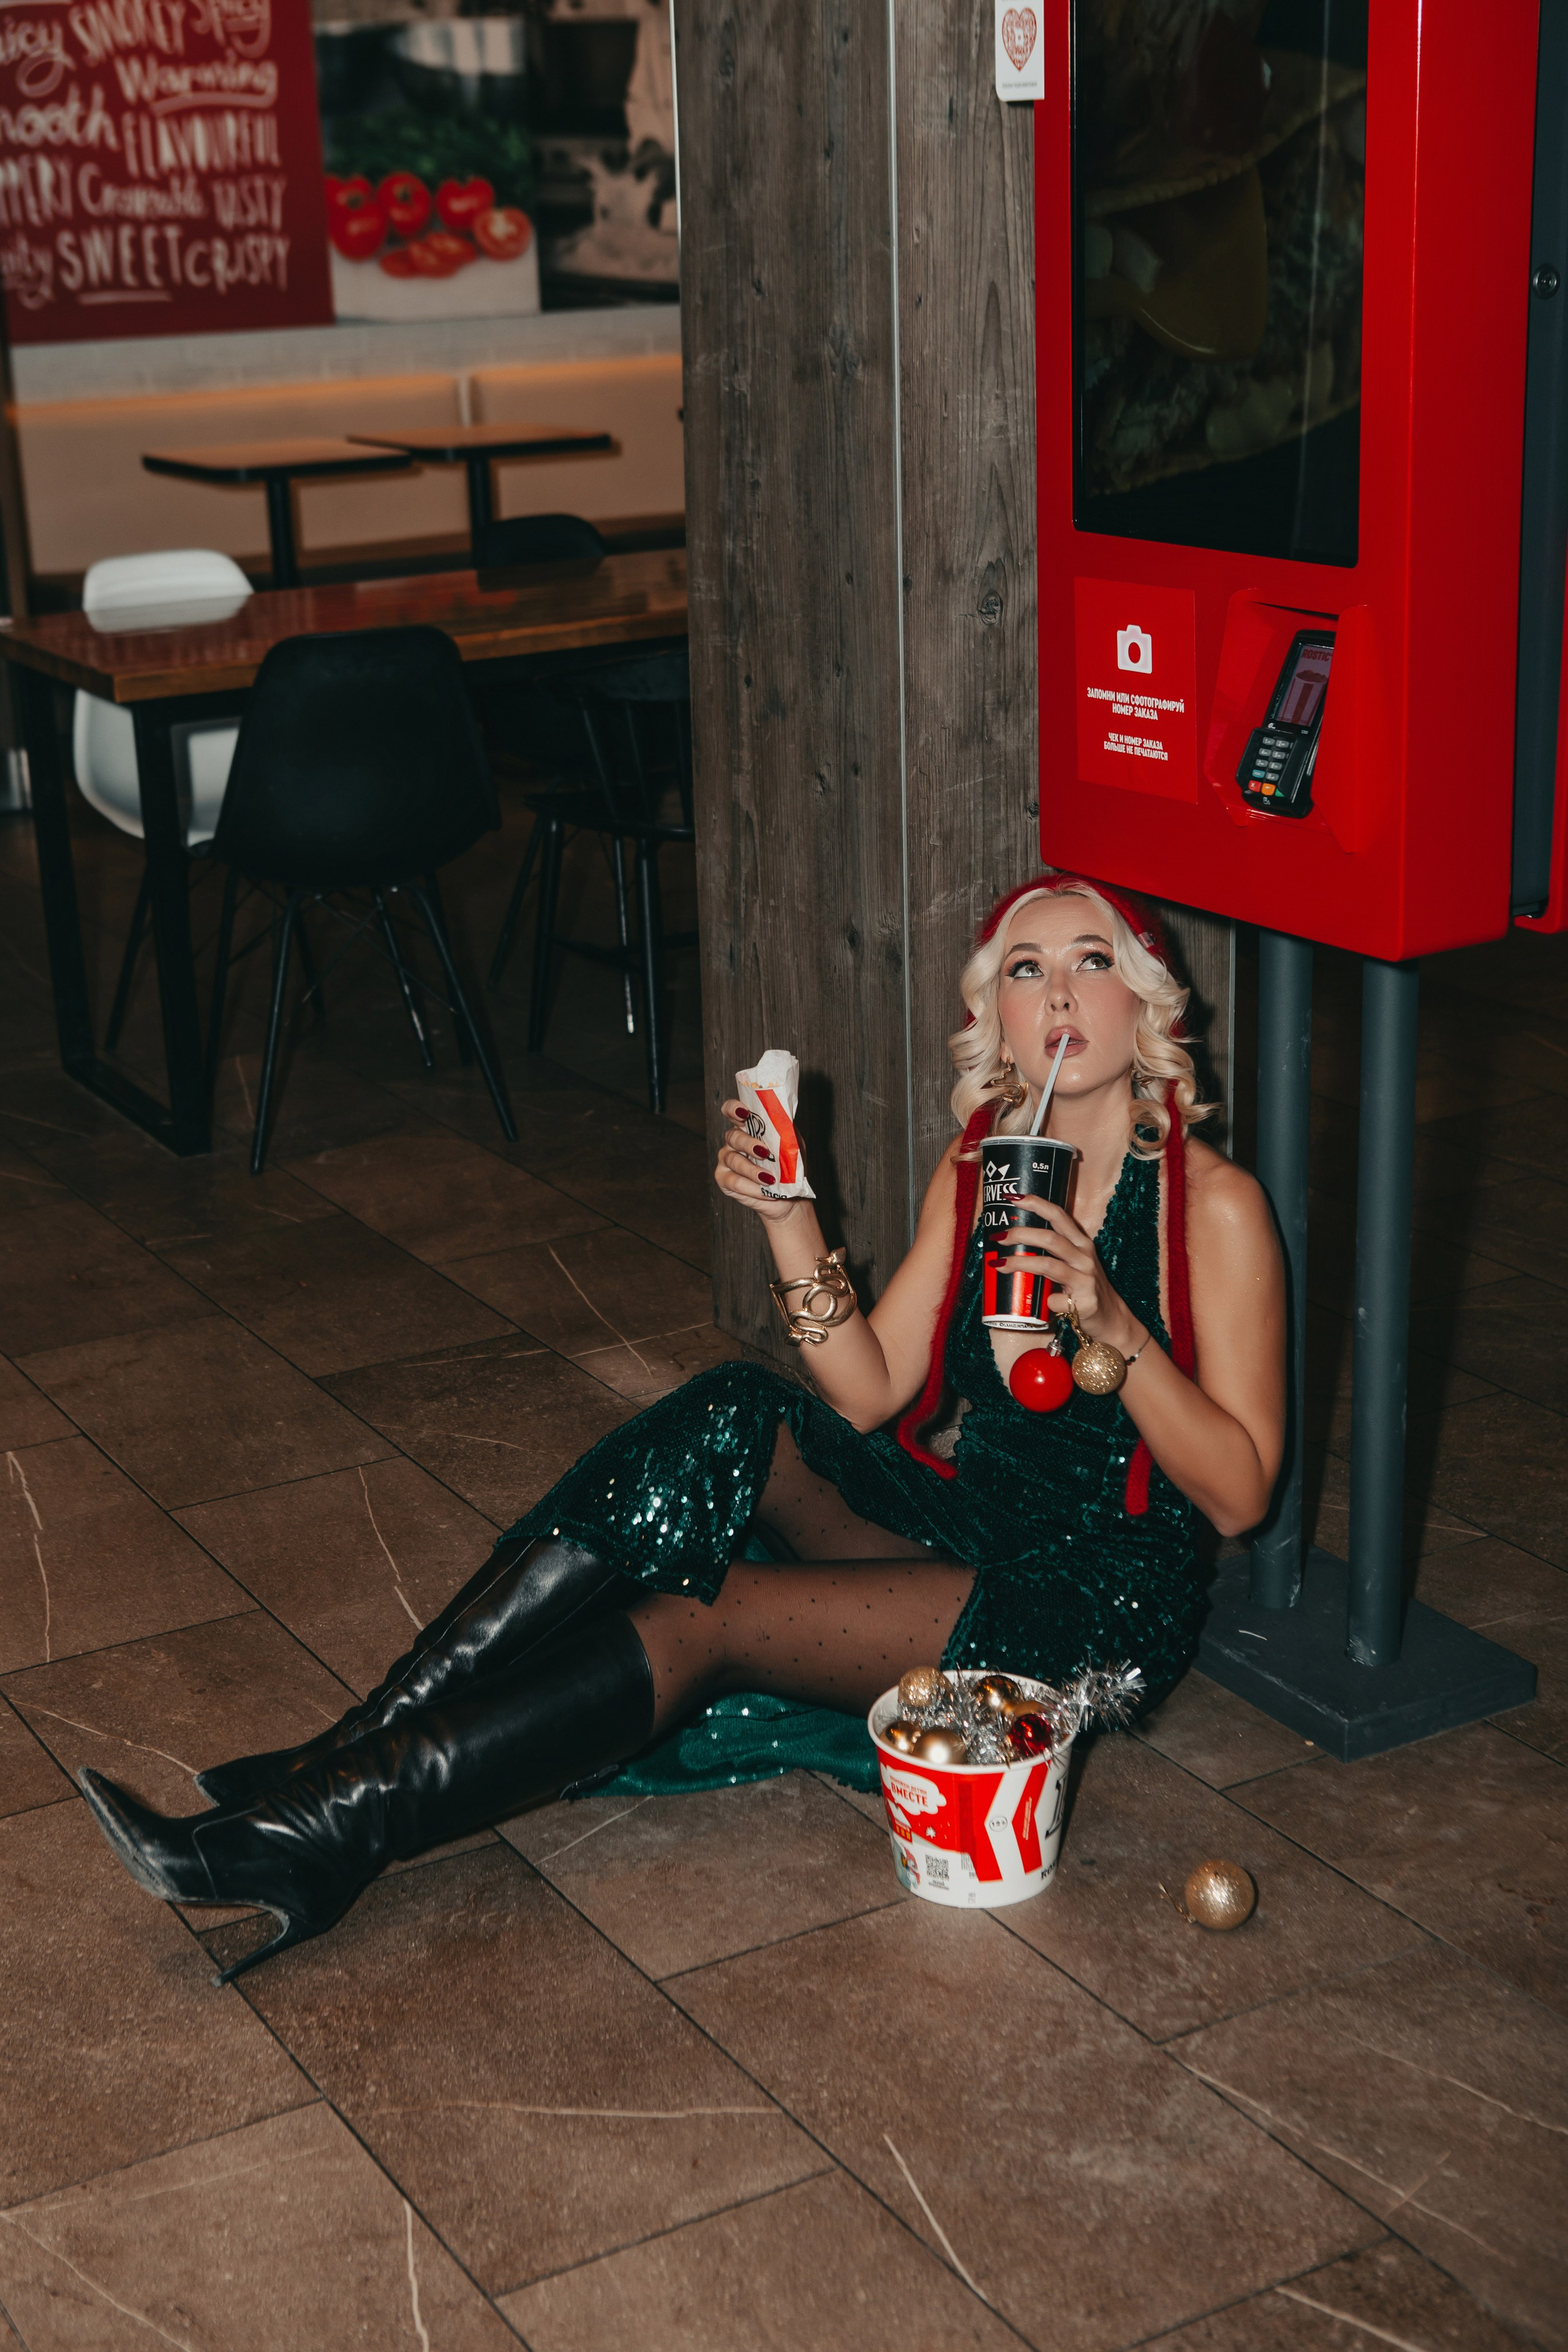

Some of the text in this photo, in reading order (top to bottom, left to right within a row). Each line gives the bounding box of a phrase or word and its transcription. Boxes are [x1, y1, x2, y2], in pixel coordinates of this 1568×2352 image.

[57, 225, 183, 290] SWEET
[184, 233, 289, 294] CRISPY
[1087, 687, 1185, 713] ЗАПОМНИ ИЛИ СФОТОГРАФИРУЙ
[1112, 703, 1158, 721] НОМЕР ЗАКАЗА
[1104, 741, 1168, 761] БОЛЬШЕ НЕ ПЕЧАТАЮТСЯ
[1108, 732, 1163, 750] ЧЕК И НОМЕР ЗАКАЗА
[982, 1210, 1009, 1227] OLA
[891, 1781, 928, 1807] ВМЕСТЕ
